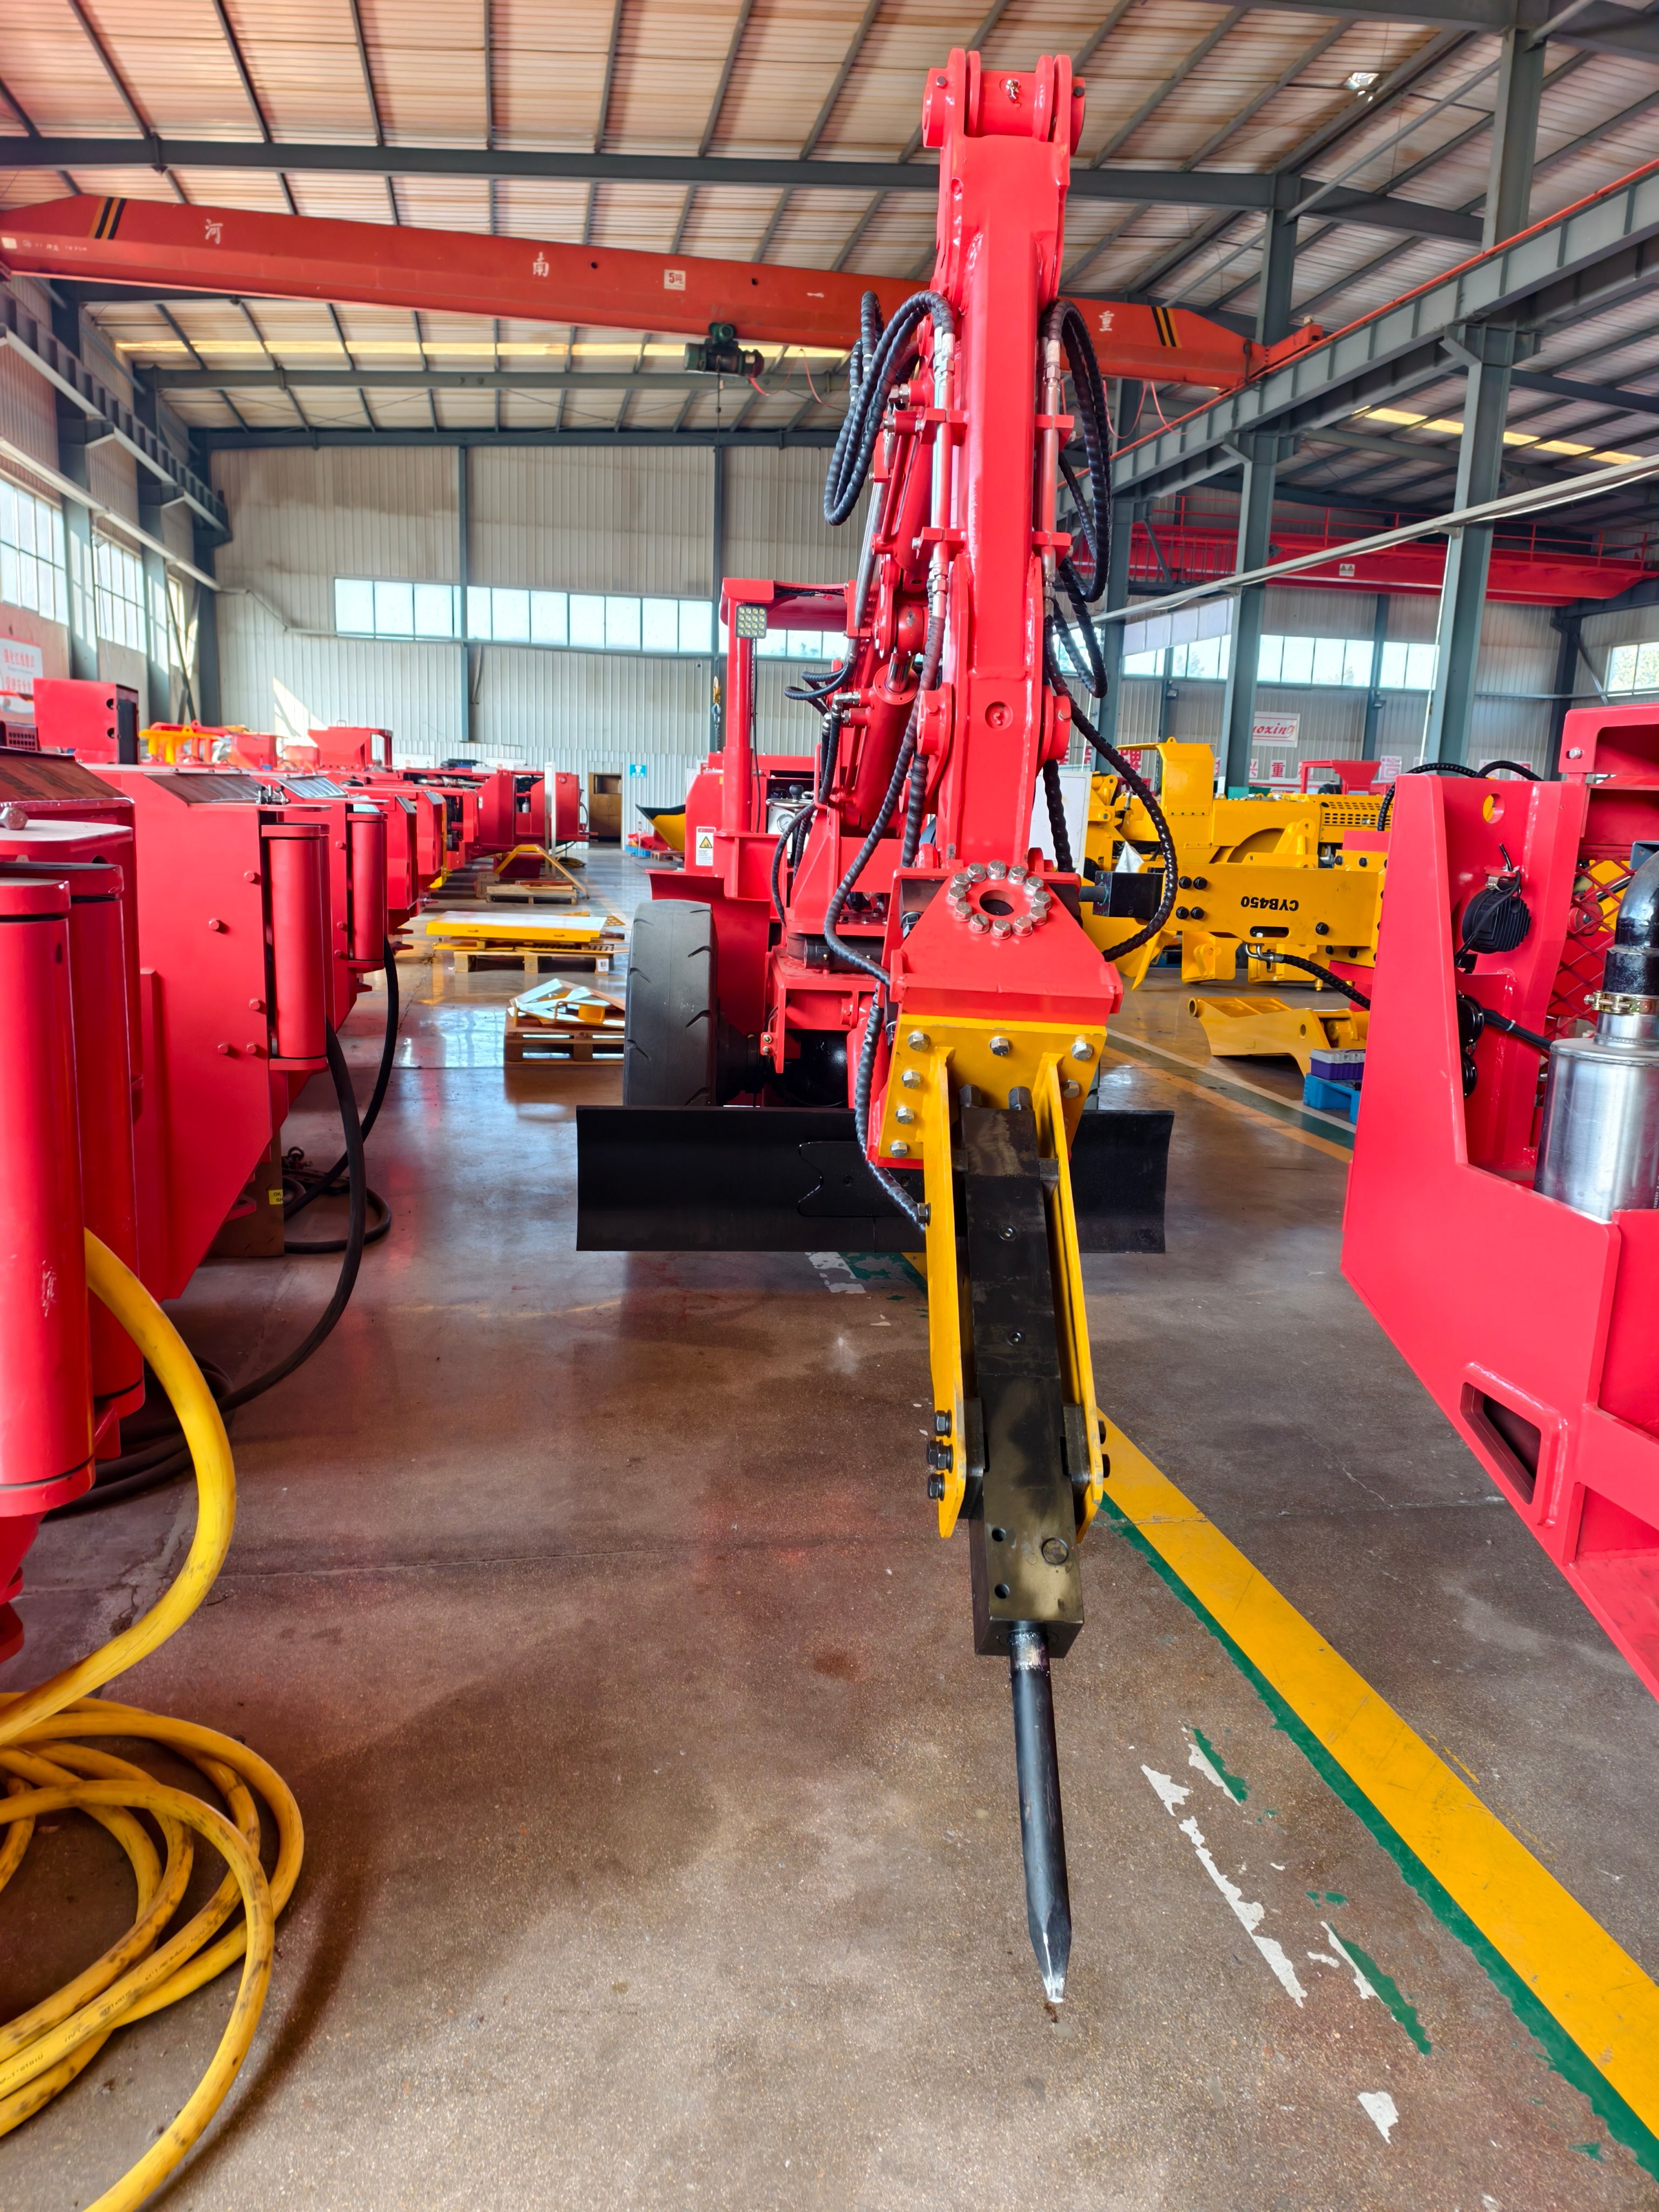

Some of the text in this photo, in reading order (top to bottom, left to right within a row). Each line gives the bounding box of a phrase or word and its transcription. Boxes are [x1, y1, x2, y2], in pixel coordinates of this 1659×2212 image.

[205, 218, 224, 244] 河
[532, 251, 550, 277] 南
[1098, 310, 1115, 332] 重
[1240, 896, 1299, 912] CYB450
